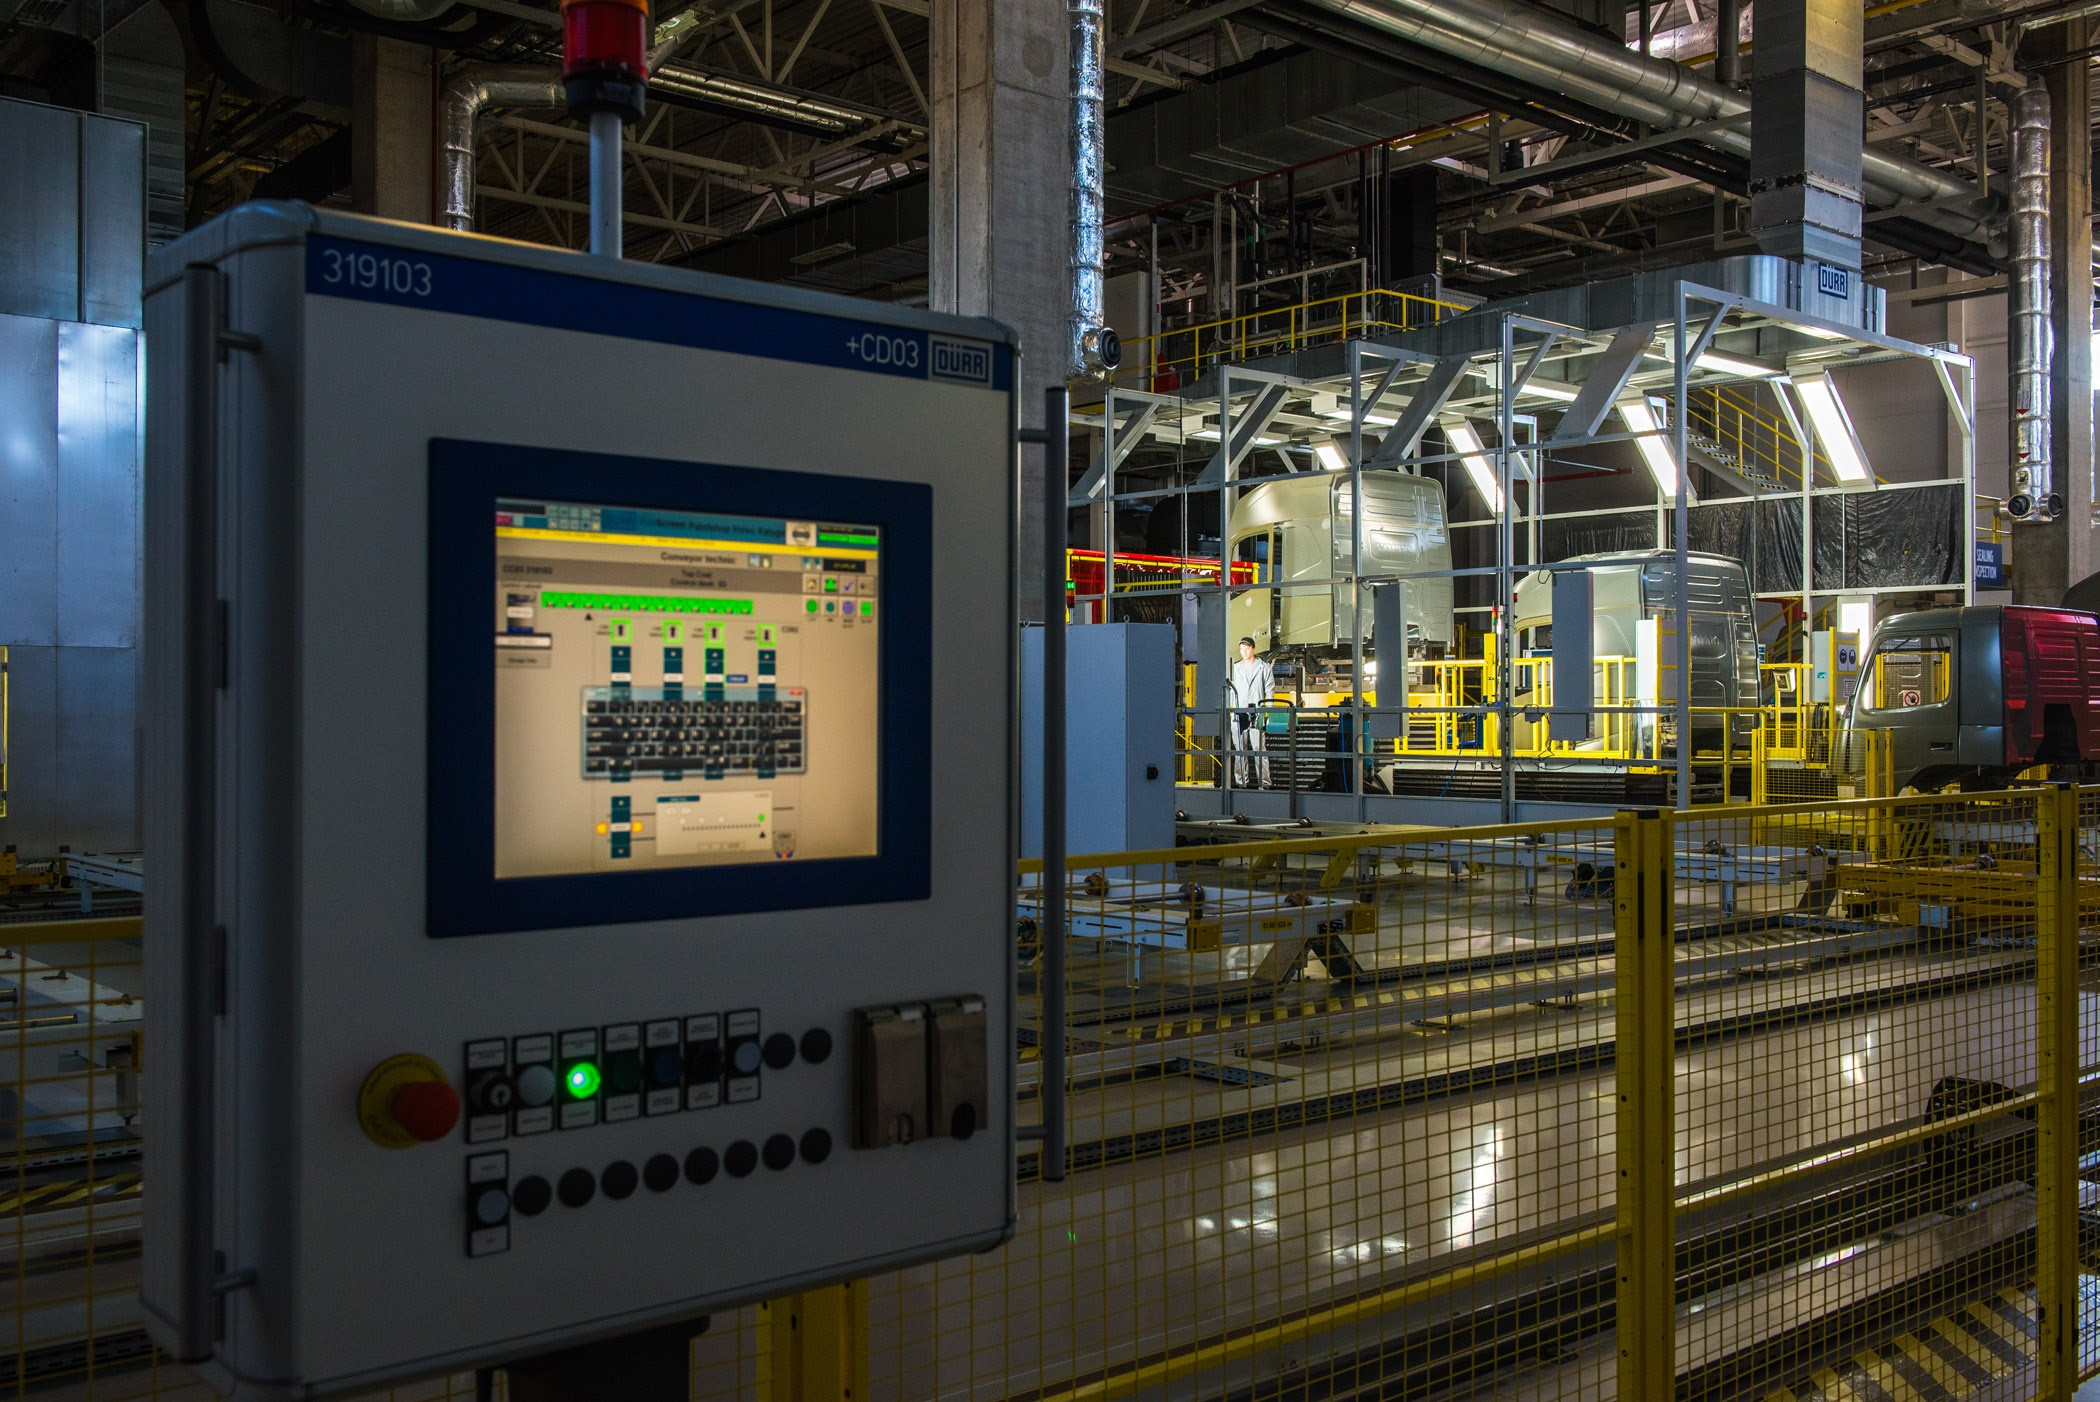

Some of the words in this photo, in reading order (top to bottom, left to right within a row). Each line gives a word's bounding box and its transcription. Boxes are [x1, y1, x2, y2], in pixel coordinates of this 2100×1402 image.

[322, 248, 433, 297] 319103
[1821, 265, 1845, 293] DÜRR
[845, 332, 920, 368] +CD03
[937, 343, 984, 376] DÜRR
[660, 551, 702, 563] Conveyor
[1977, 549, 1994, 563] SEALING
